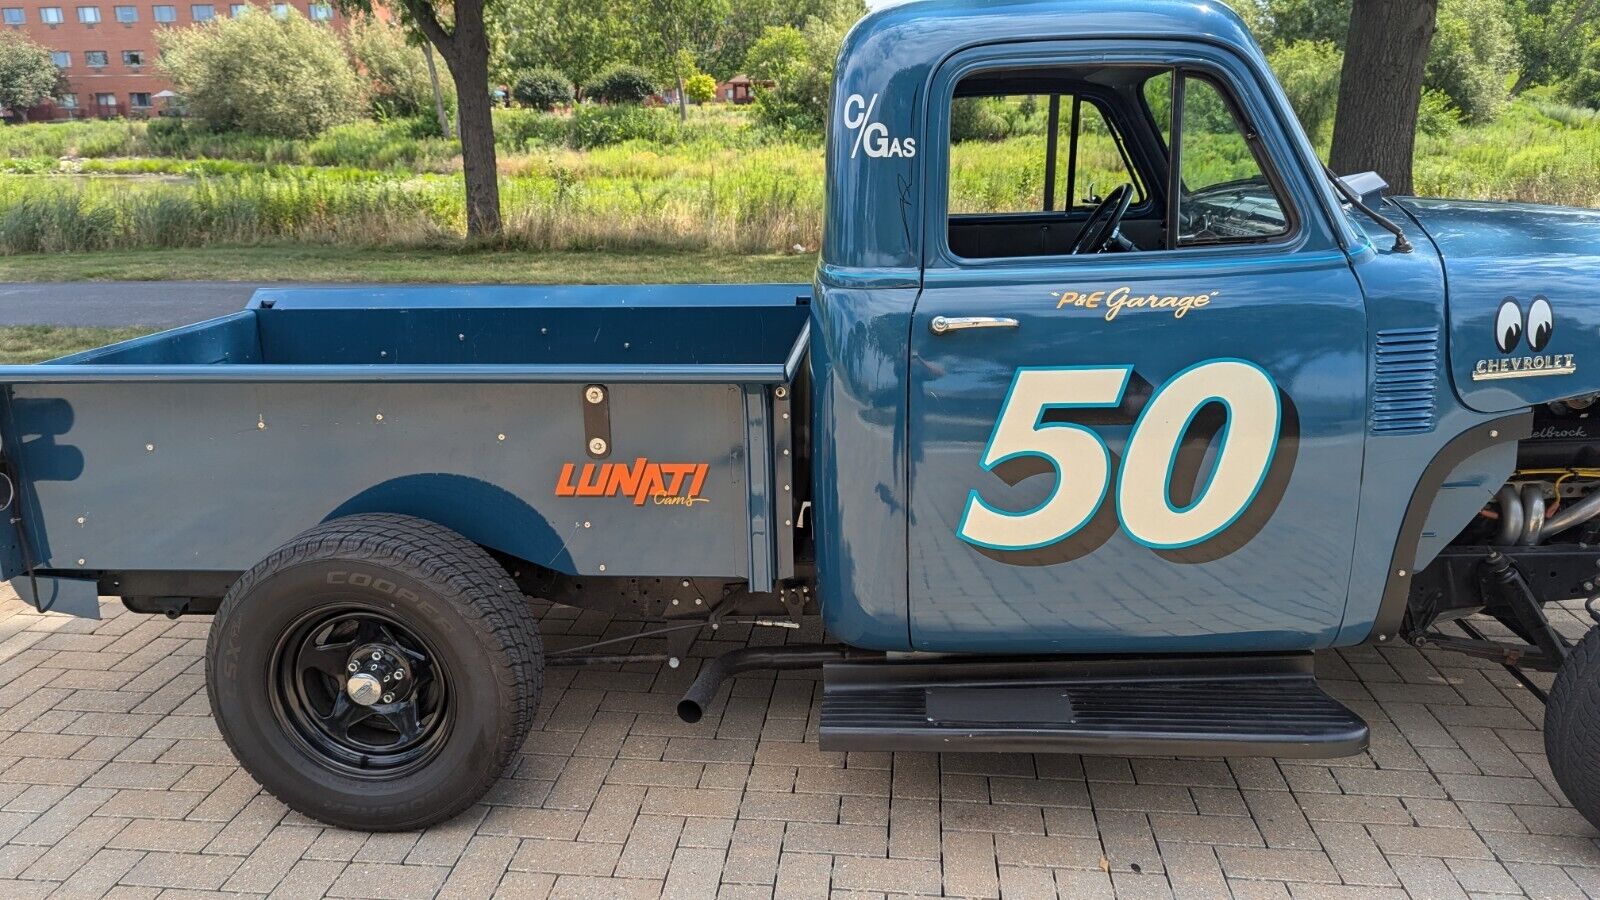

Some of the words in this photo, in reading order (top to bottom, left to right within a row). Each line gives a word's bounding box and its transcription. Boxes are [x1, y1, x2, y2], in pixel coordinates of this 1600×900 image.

[1476, 353, 1575, 374] CHEVROLET
[1532, 426, 1588, 438] elbrock
[956, 358, 1284, 551] 50
[555, 457, 709, 507] LUNATI
[653, 490, 710, 507] Cams
[326, 571, 457, 633] COOPER
